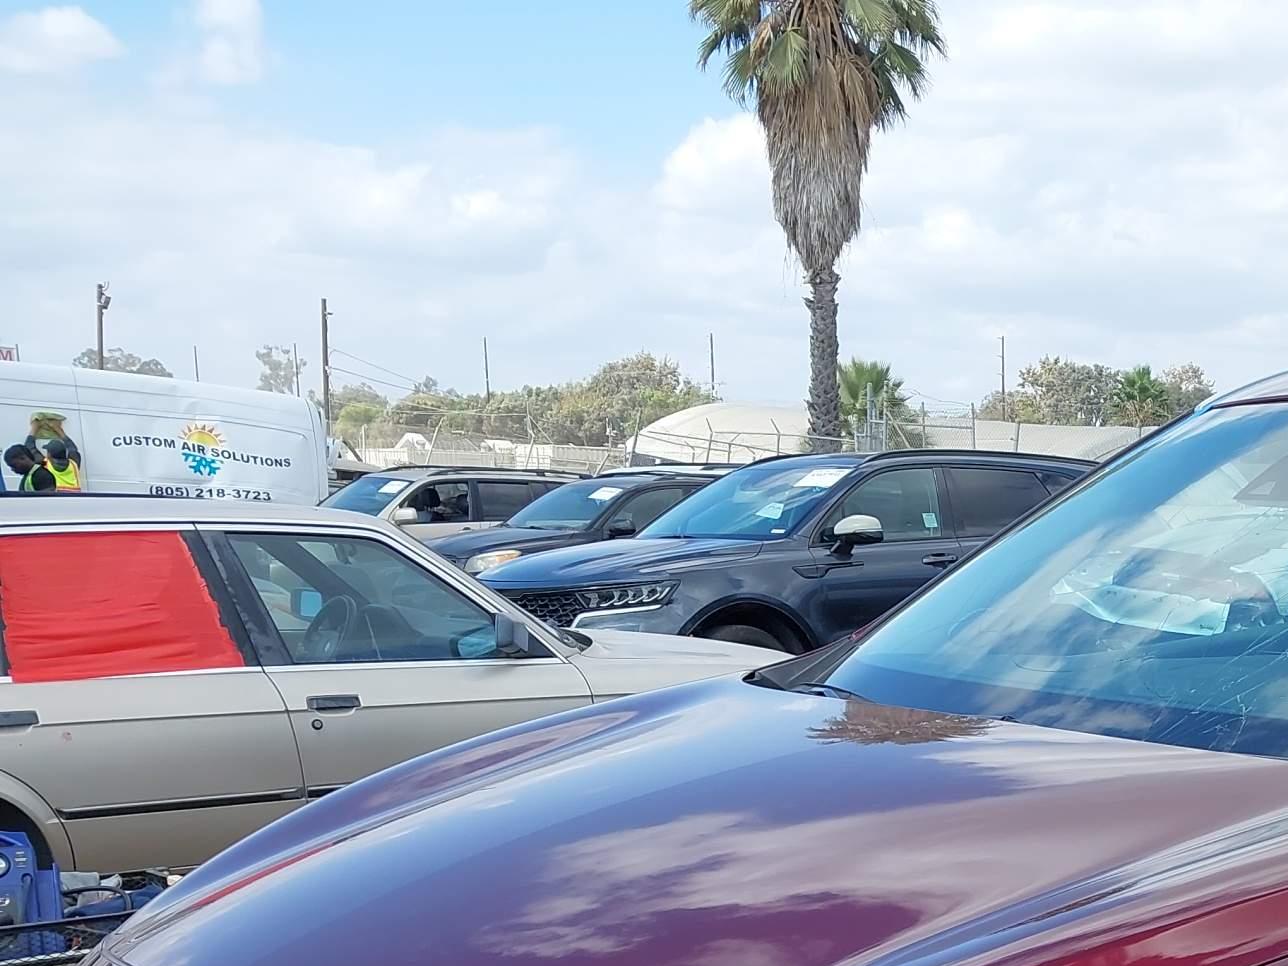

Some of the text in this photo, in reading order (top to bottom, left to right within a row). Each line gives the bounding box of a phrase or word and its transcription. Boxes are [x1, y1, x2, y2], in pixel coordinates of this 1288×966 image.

[112, 435, 292, 468] CUSTOM AIR SOLUTIONS
[149, 484, 272, 501] (805) 218-3723
